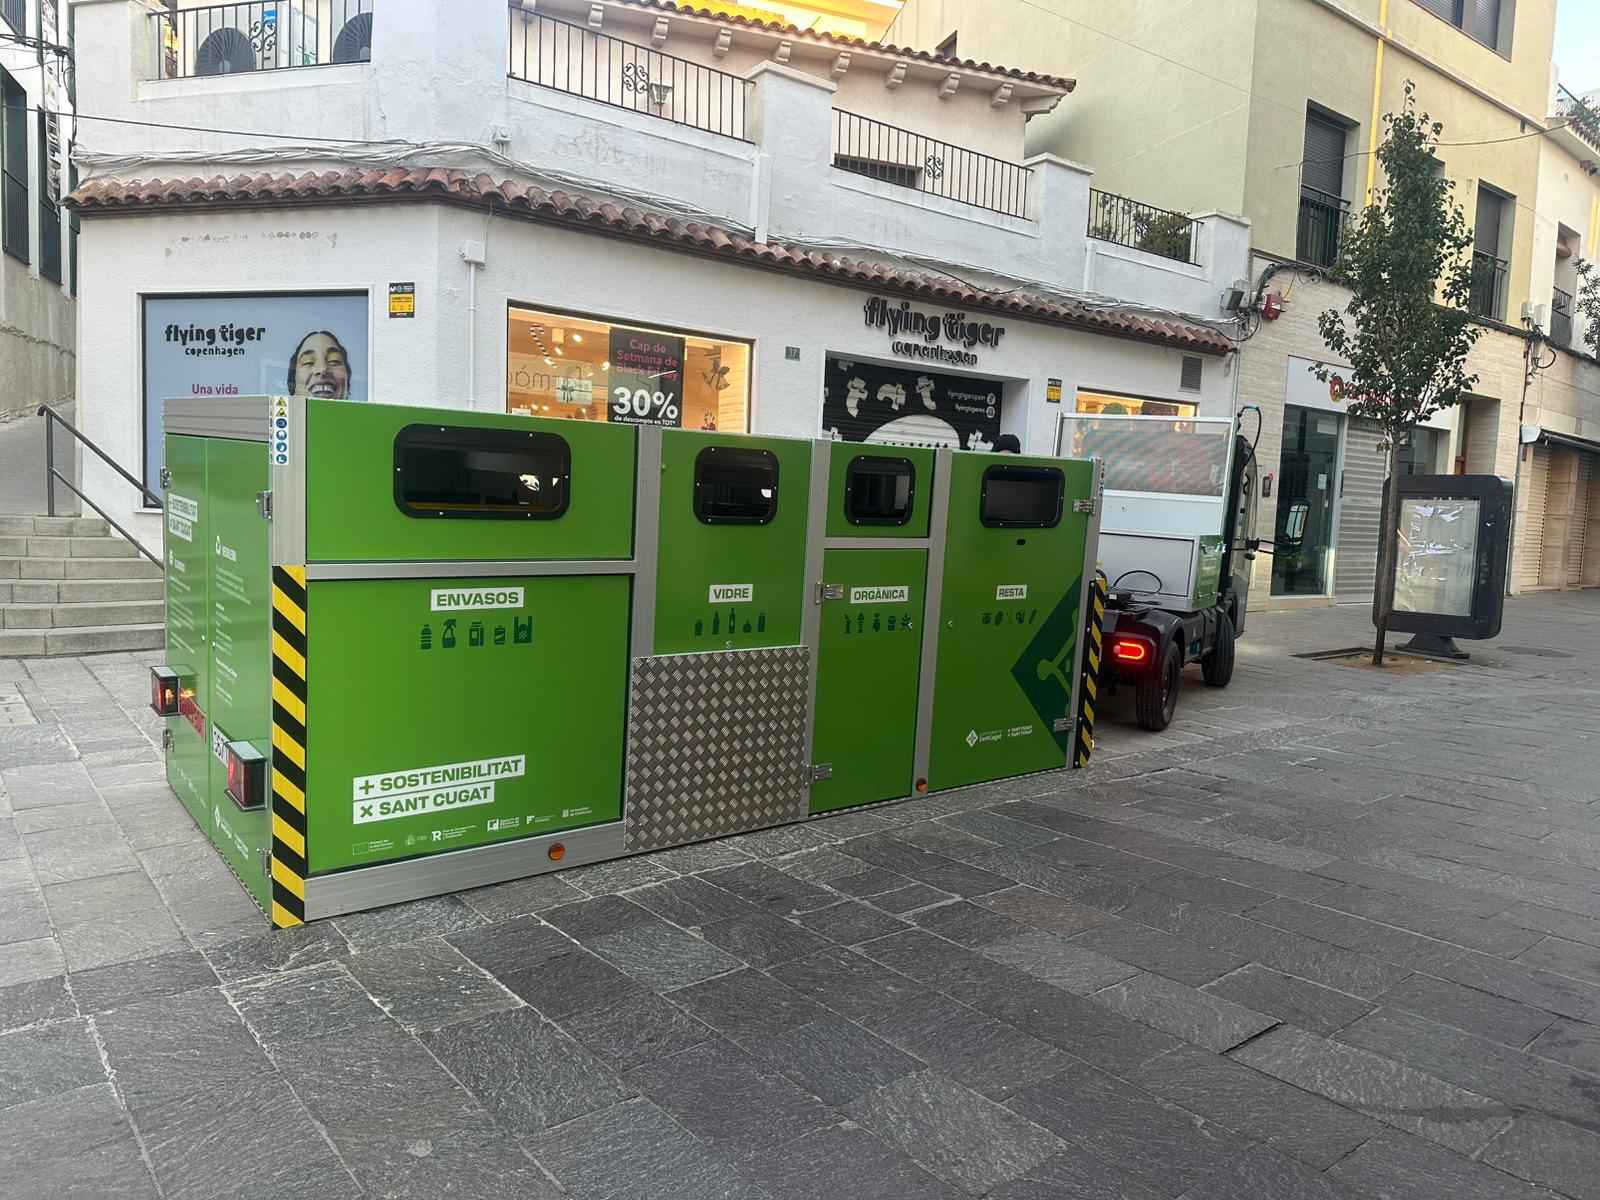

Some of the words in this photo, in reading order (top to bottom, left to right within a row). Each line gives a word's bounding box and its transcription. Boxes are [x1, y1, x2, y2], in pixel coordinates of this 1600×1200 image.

[864, 297, 941, 342] flying
[942, 312, 1005, 348] tiger
[164, 323, 216, 346] flying
[218, 323, 266, 346] tiger
[184, 346, 245, 357] copenhagen
[629, 339, 650, 353] Cap
[653, 342, 666, 354] de
[891, 341, 978, 365] copenhagen
[616, 350, 662, 365] Setmana
[664, 356, 678, 367] de
[616, 362, 644, 375] Black
[192, 384, 213, 394] Una
[215, 384, 239, 394] vida
[612, 387, 679, 419] 30%
[623, 416, 653, 425] descompte
[436, 591, 519, 607] ENVASOS
[712, 587, 750, 600] VIDRE
[853, 587, 905, 601] ORGÀNICA
[998, 587, 1025, 598] RESTA
[379, 759, 522, 792] SOSTENIBILITAT
[379, 796, 429, 816] SANT
[432, 786, 491, 807] CUGAT
